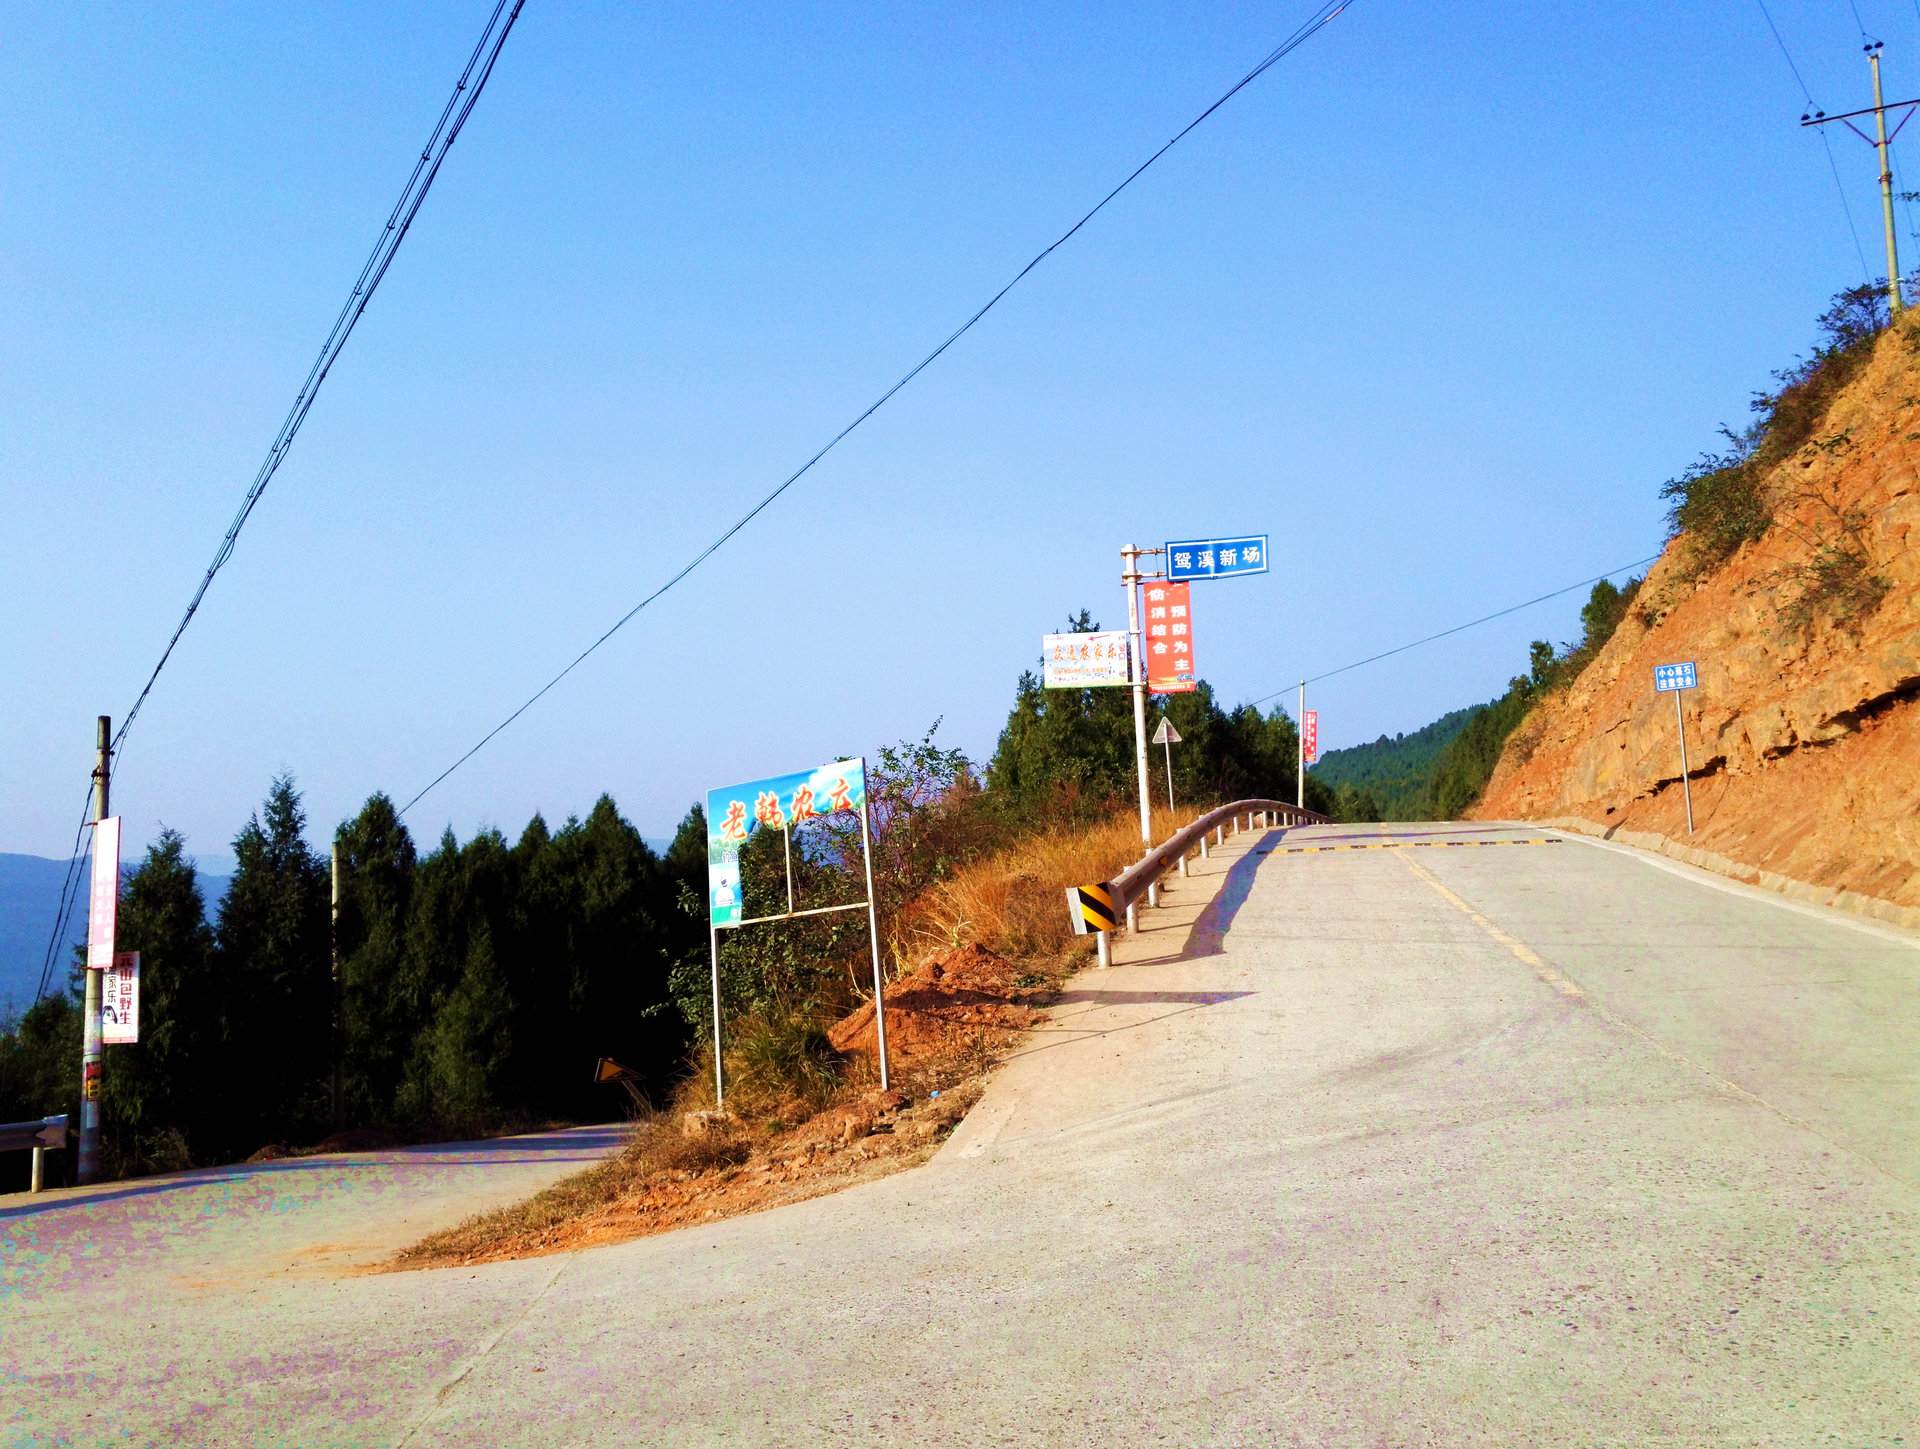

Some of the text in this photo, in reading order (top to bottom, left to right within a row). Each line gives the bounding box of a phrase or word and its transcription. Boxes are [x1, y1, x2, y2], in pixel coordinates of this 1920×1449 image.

[1174, 546, 1260, 569] 鸳溪新场
[1149, 588, 1168, 654] 防消结合
[1170, 605, 1190, 671] 预防为主
[1660, 676, 1693, 689] 注意安全
